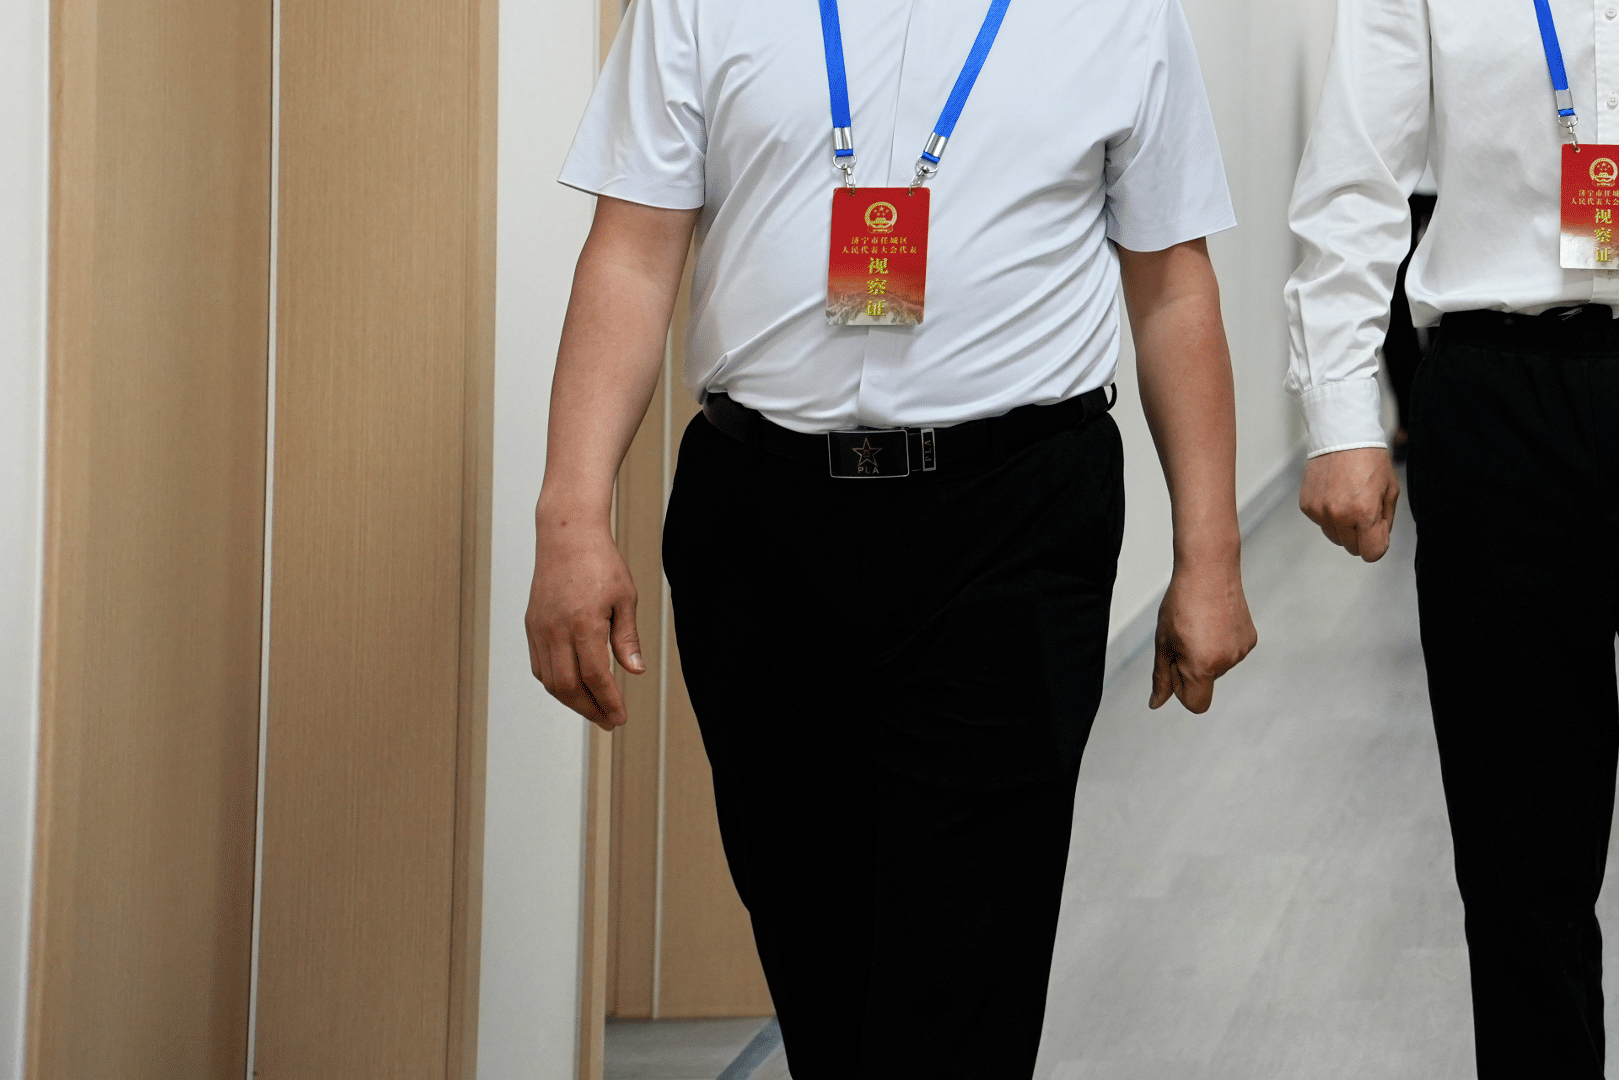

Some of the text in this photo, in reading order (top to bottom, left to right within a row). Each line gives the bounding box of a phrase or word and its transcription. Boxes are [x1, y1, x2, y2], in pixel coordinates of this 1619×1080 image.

[851, 236, 908, 245] 济宁市任城区
[1594, 208, 1612, 262] 视察证
[842, 246, 917, 254] 人民代表大会代表
[867, 257, 889, 316] 视察证
[924, 439, 932, 462] PLA
[857, 466, 880, 474] PLA
